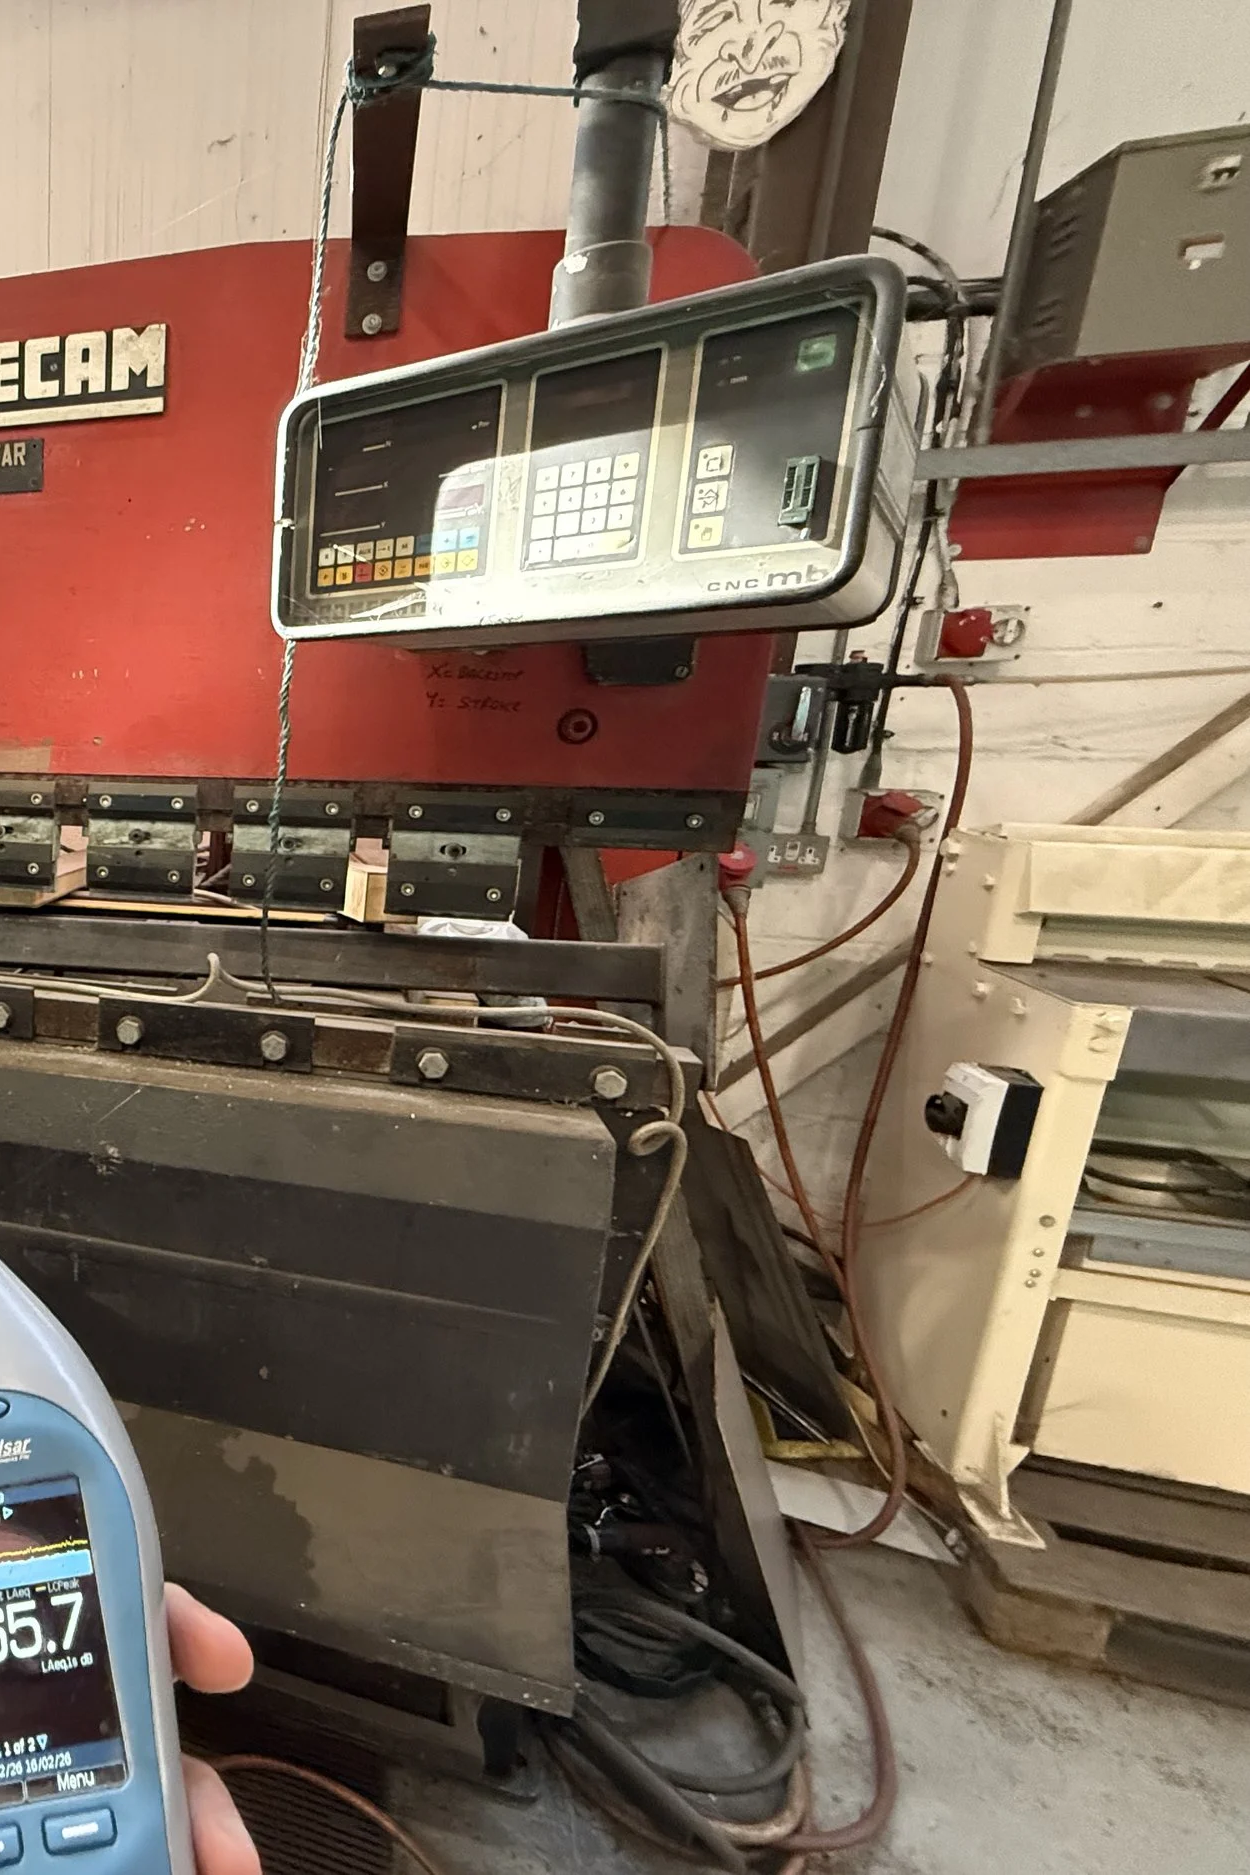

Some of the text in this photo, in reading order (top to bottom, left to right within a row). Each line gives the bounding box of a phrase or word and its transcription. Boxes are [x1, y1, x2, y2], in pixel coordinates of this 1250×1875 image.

[707, 578, 759, 592] CNC
[6, 1587, 31, 1601] LAeq
[4, 1736, 36, 1757] 1 of 2
[57, 1770, 96, 1792] Menu
